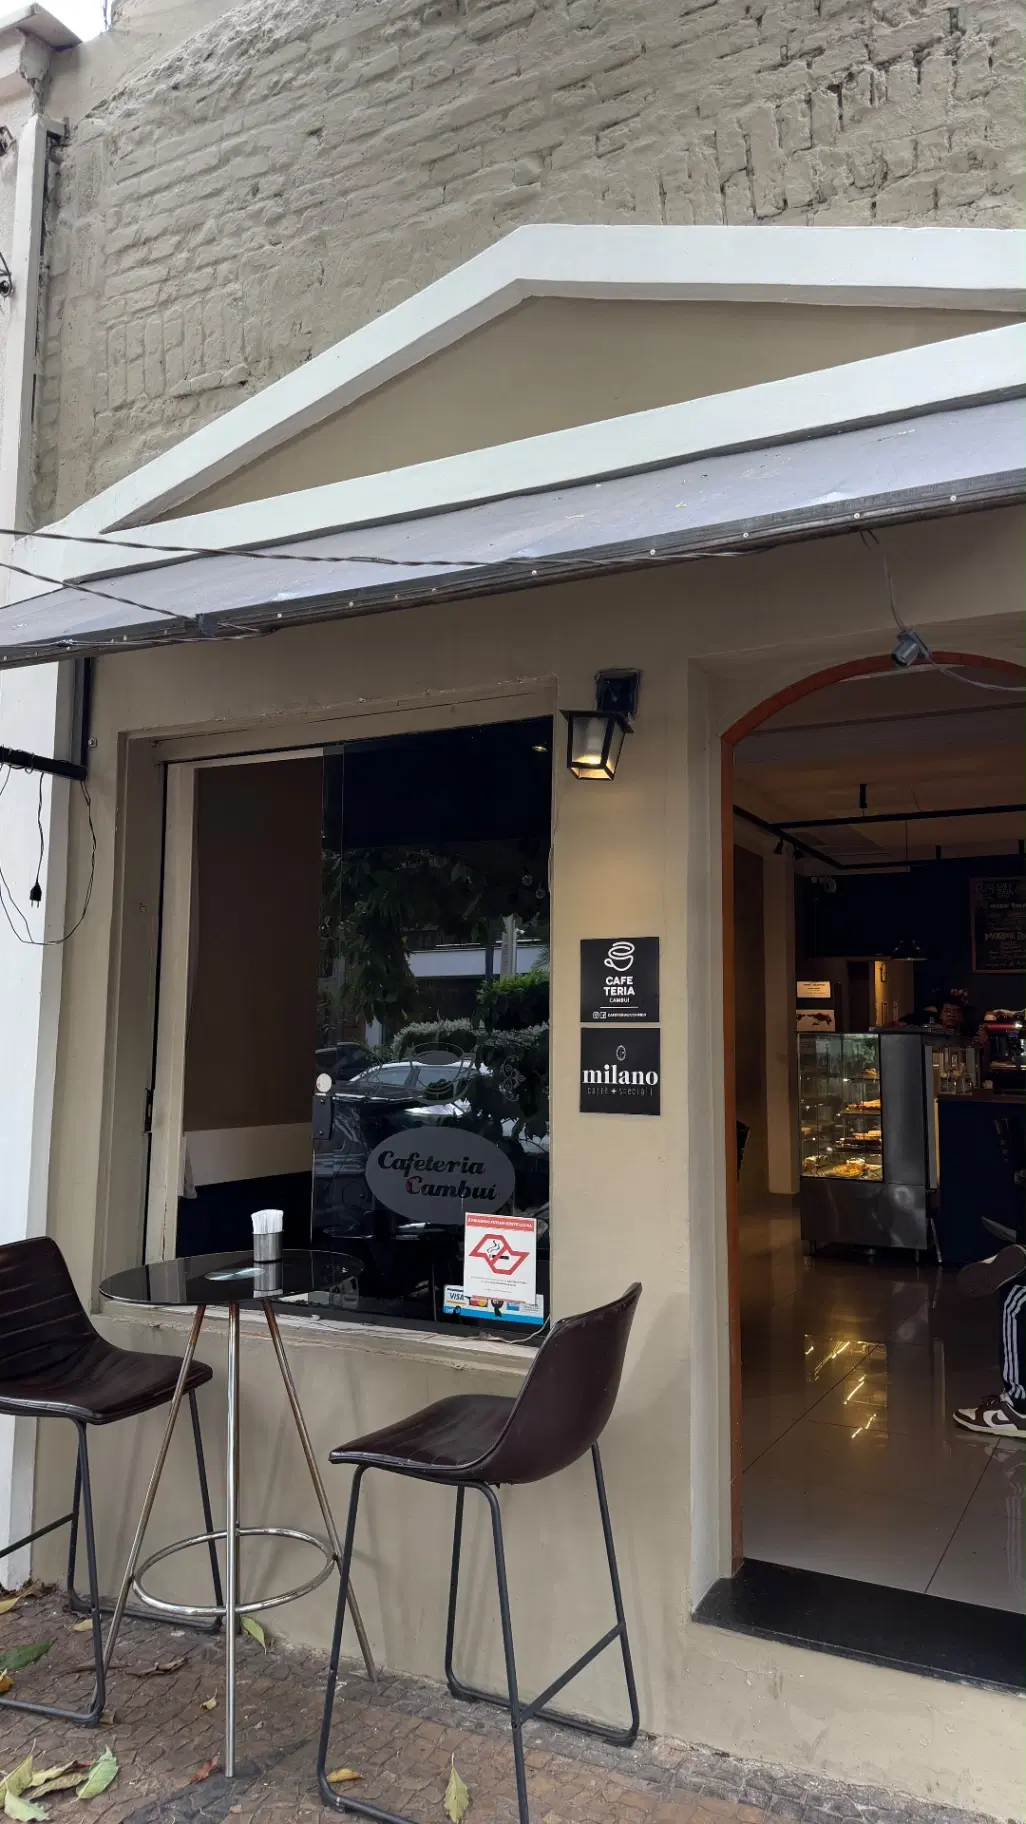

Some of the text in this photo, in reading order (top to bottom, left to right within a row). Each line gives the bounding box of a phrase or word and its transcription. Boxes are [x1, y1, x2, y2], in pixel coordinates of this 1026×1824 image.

[605, 976, 634, 986] CAFE
[603, 986, 636, 996] TERIA
[582, 1064, 659, 1086] milano
[377, 1150, 486, 1178] Cafeteria
[449, 1292, 465, 1301] VISA
